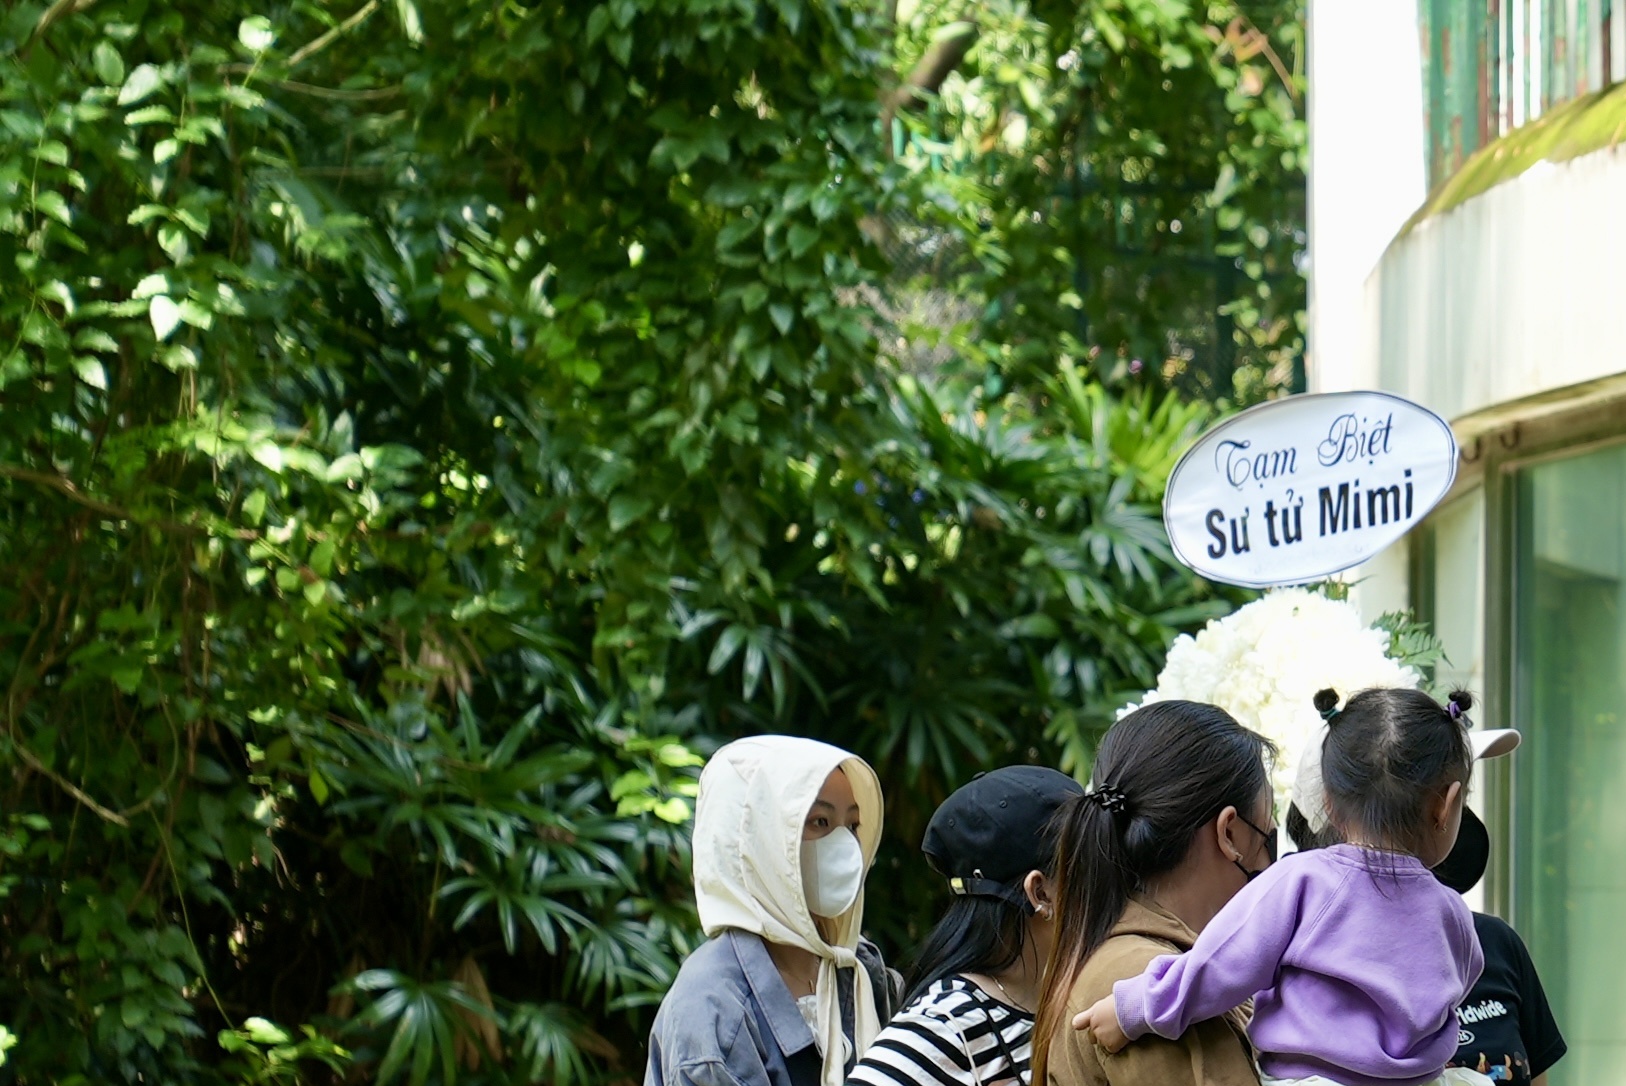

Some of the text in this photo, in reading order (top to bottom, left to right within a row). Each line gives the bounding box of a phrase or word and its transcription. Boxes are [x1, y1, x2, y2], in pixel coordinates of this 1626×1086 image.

[1215, 412, 1393, 491] Tạm Biệt
[1205, 468, 1414, 559] Sư tử Mimi
